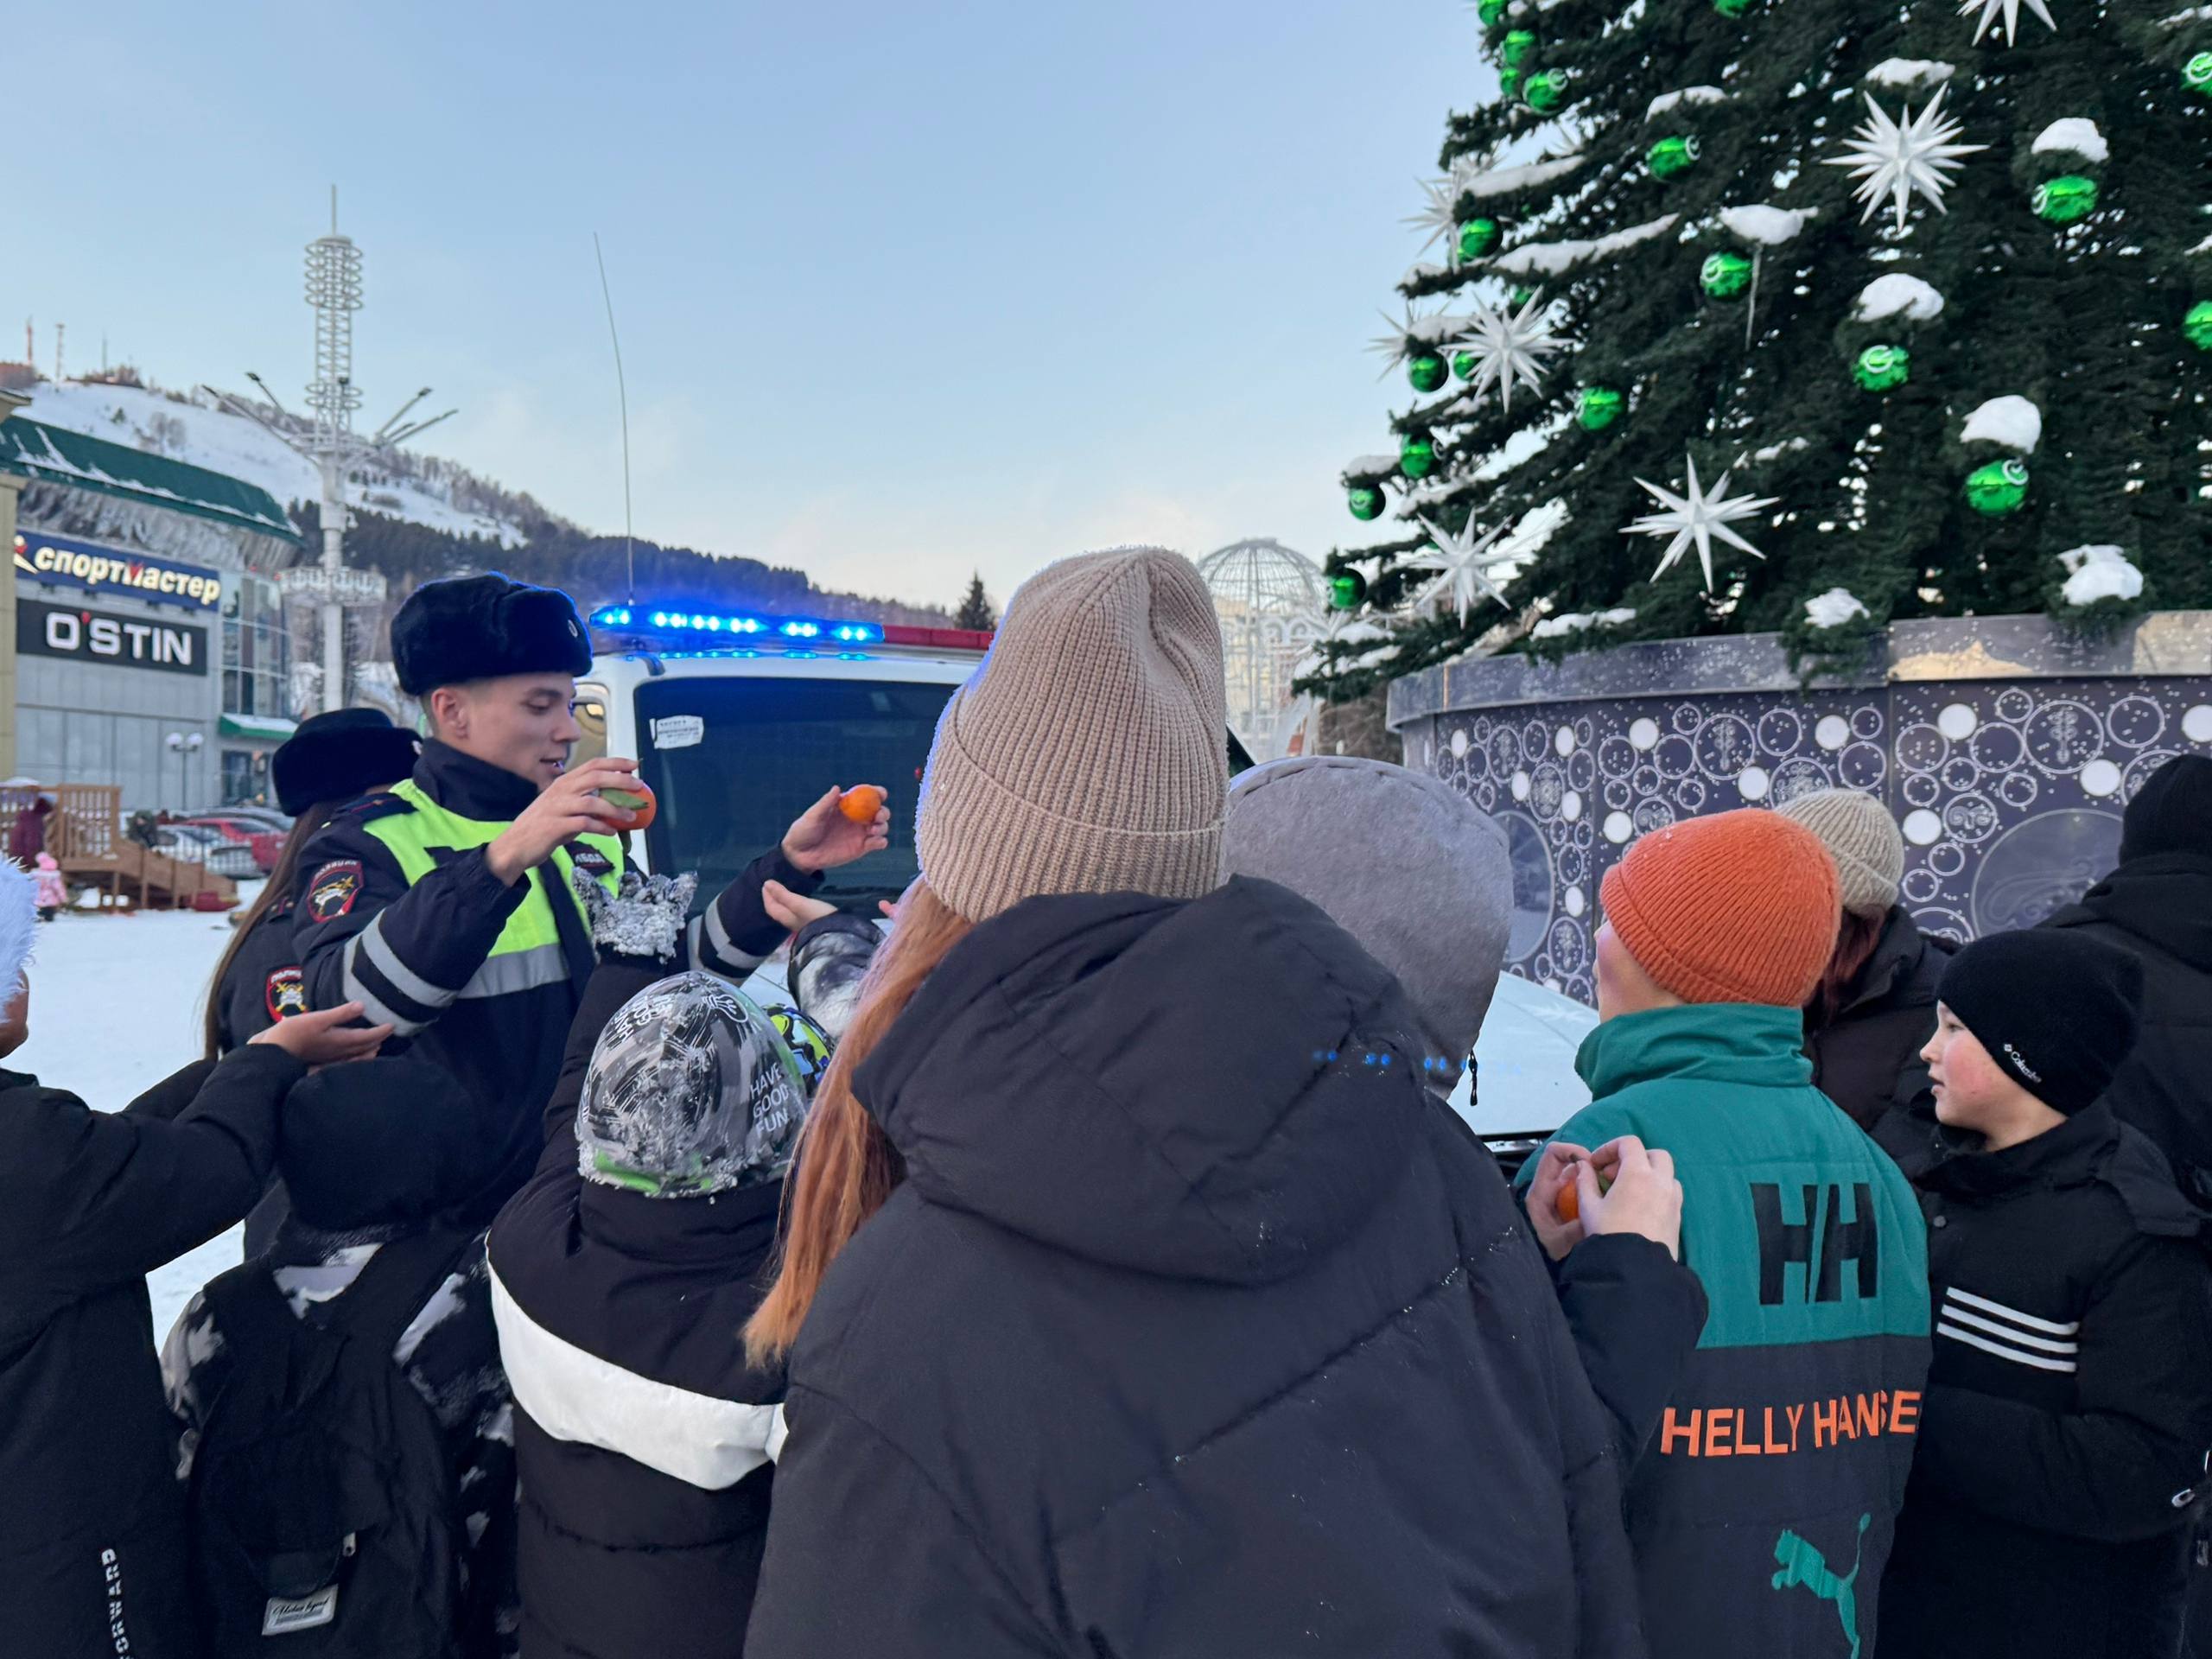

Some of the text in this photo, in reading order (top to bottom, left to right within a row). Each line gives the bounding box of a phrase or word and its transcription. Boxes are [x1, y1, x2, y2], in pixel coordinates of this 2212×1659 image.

[34, 546, 221, 605] спортмастер
[46, 611, 193, 665] O'STIN
[750, 1062, 781, 1100] HAVE
[753, 1083, 790, 1119] GOOD
[755, 1107, 789, 1139] FUN
[1660, 1403, 1804, 1457] HELLY
